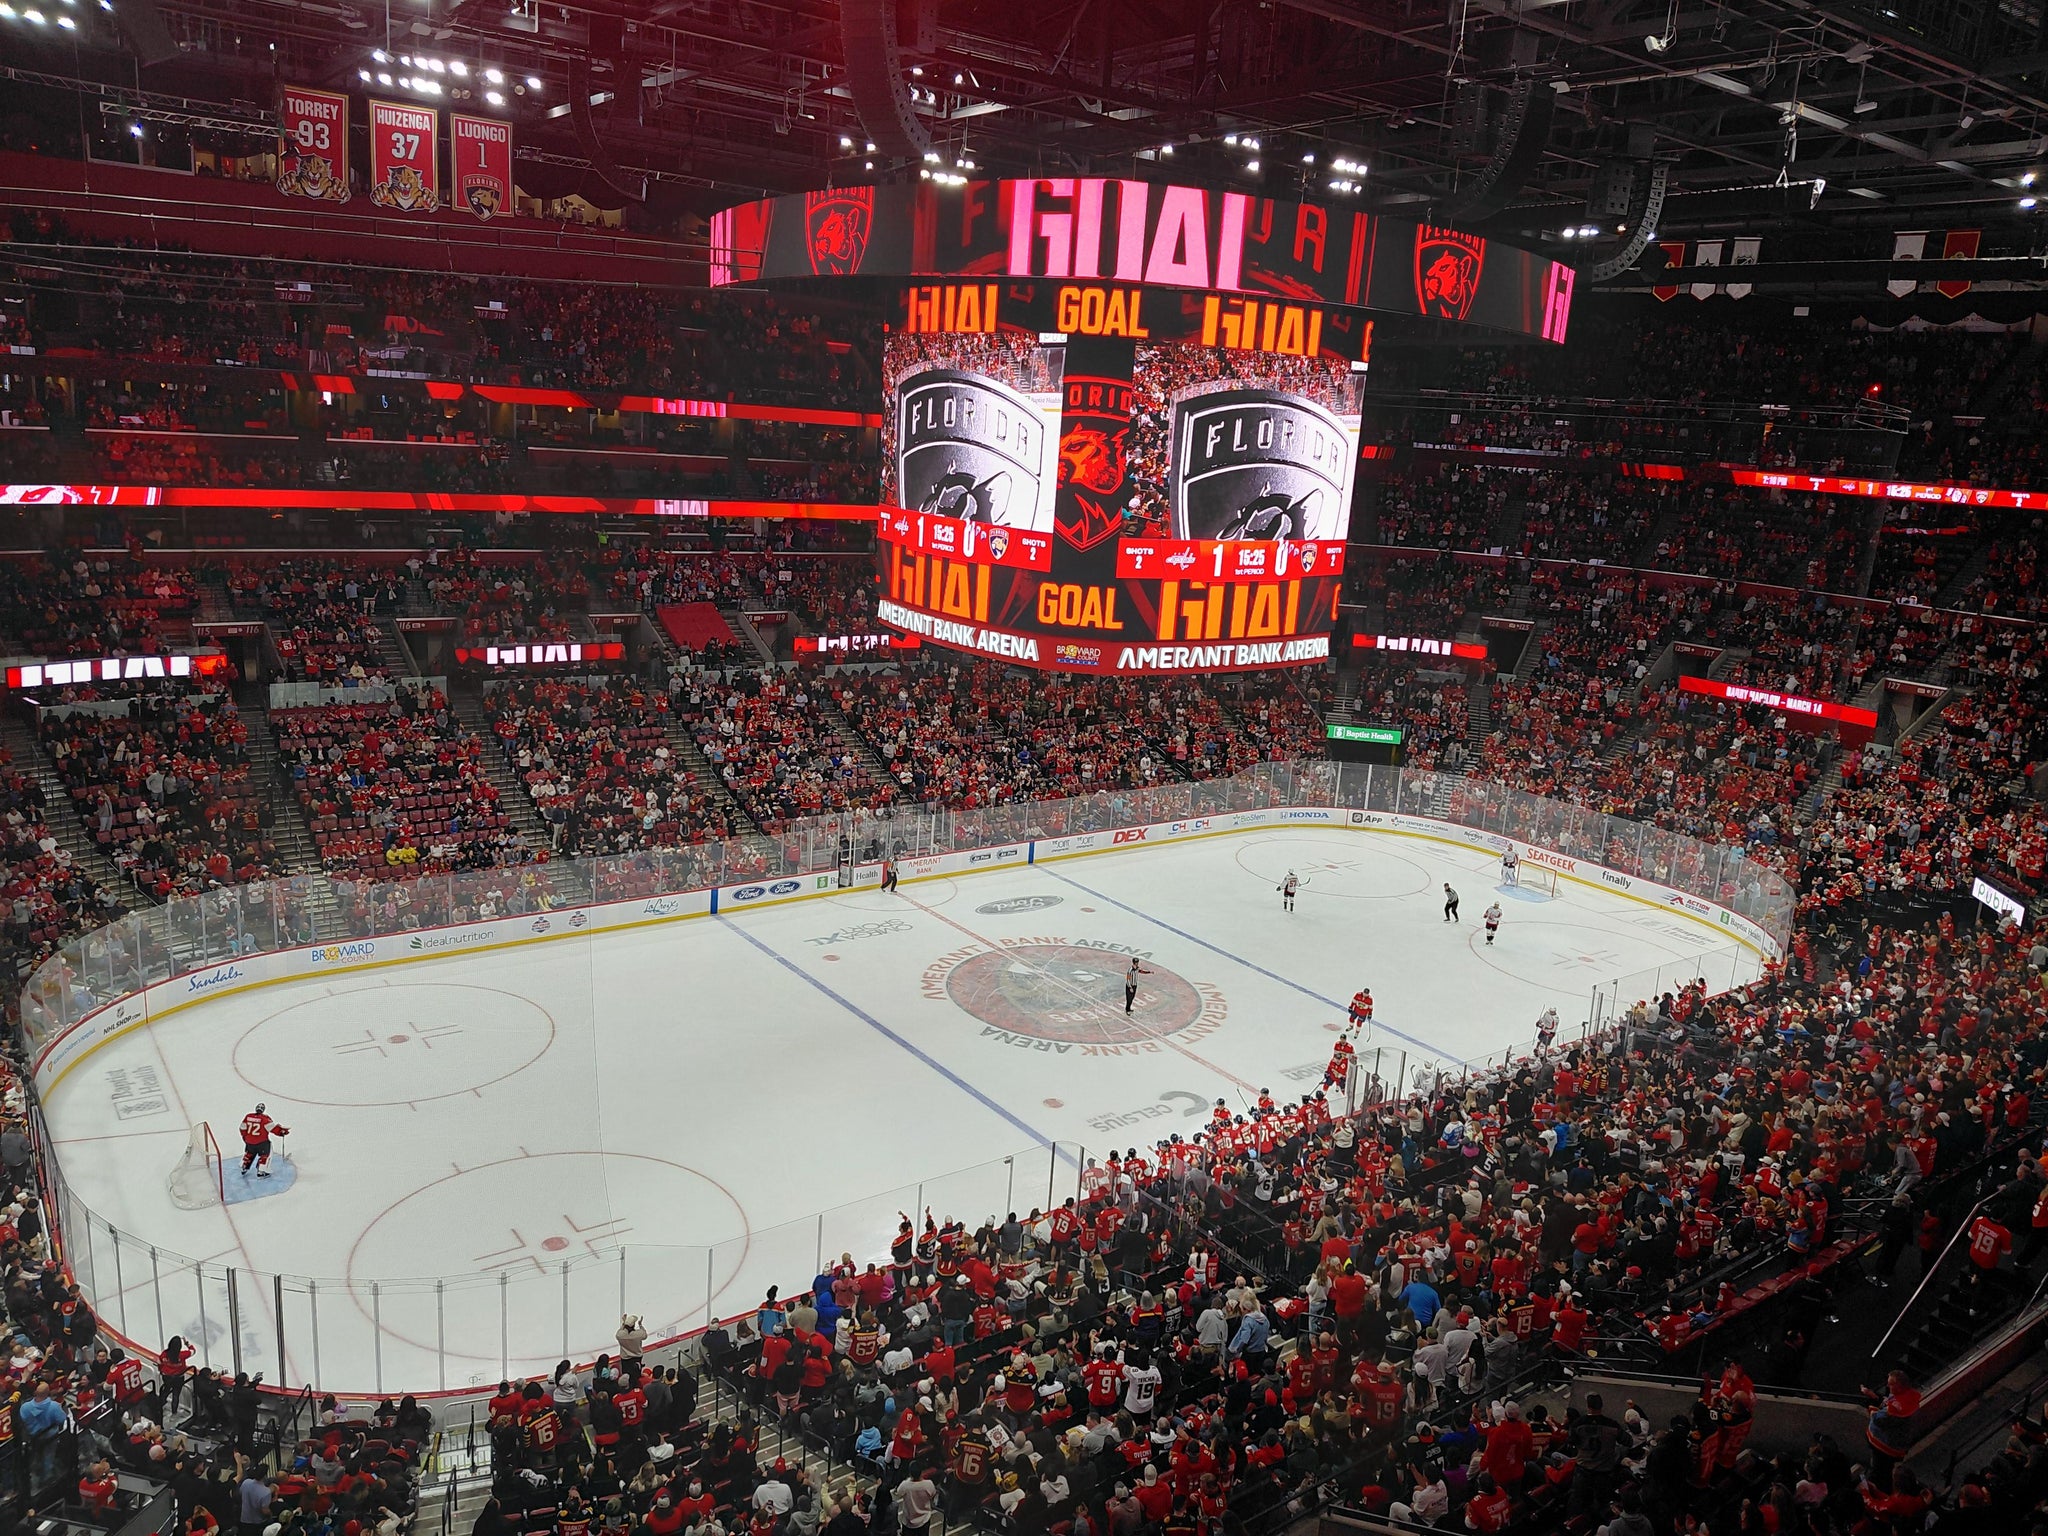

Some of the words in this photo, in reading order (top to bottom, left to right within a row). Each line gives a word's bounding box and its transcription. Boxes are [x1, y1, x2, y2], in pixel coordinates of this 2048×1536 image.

[286, 97, 339, 121] TORREY
[376, 108, 431, 132] HUIZENGA
[298, 121, 330, 150] 93
[458, 121, 506, 143] LUONGO
[391, 132, 420, 160] 37
[477, 142, 488, 168] 1
[1058, 286, 1149, 338] GOAL
[1206, 417, 1339, 473] FLORIDA
[917, 516, 925, 547] 1
[933, 524, 954, 543] 15:25
[1022, 538, 1046, 548] SHOTS
[1125, 547, 1154, 555] SHOTS
[1029, 547, 1036, 560] 2
[1135, 555, 1142, 570] 2
[1212, 544, 1224, 577] 1
[1238, 549, 1265, 566] 15:25
[1038, 582, 1124, 630] GOAL
[877, 599, 932, 636] AMERANT
[933, 618, 977, 648] BANK
[977, 629, 1040, 662] ARENA
[1056, 644, 1101, 658] BROWARD
[1117, 645, 1234, 669] AMERANT
[1234, 642, 1283, 665] BANK
[1283, 637, 1329, 661] ARENA
[1786, 698, 1813, 713] MARCH
[1813, 703, 1823, 714] 14
[1346, 729, 1370, 741] Baptist
[1371, 731, 1394, 741] Health
[1195, 819, 1210, 828] CH
[1113, 828, 1149, 844] DEX
[907, 857, 941, 868] AMERANT
[1527, 848, 1577, 874] SEATGEEK
[855, 870, 878, 881] Health
[916, 867, 933, 875] BANK
[1602, 870, 1632, 890] finally
[739, 888, 760, 899] Ford
[774, 883, 796, 895] Ford
[1687, 899, 1711, 912] ACTION
[1730, 918, 1747, 934] Baptist
[311, 942, 375, 963] BROWARD
[999, 936, 1068, 947] BANK
[1074, 938, 1155, 960] ARENA
[341, 953, 376, 964] COUNTY
[188, 966, 243, 992] Sandals
[920, 944, 983, 1001] AMERANT
[1185, 981, 1228, 1045] AMERANT
[979, 1025, 1073, 1053] ARENA
[1081, 1042, 1162, 1057] BANK
[1090, 1103, 1173, 1133] CELSIUS
[1056, 1217, 1069, 1234] 19
[1975, 1231, 1995, 1254] 19
[1517, 1316, 1531, 1334] 19
[856, 1341, 876, 1357] 63
[123, 1370, 140, 1390] 16
[1101, 1376, 1112, 1394] 9
[1137, 1382, 1155, 1400] 19
[1376, 1401, 1395, 1420] 19
[537, 1427, 554, 1445] 16
[962, 1452, 982, 1476] 16
